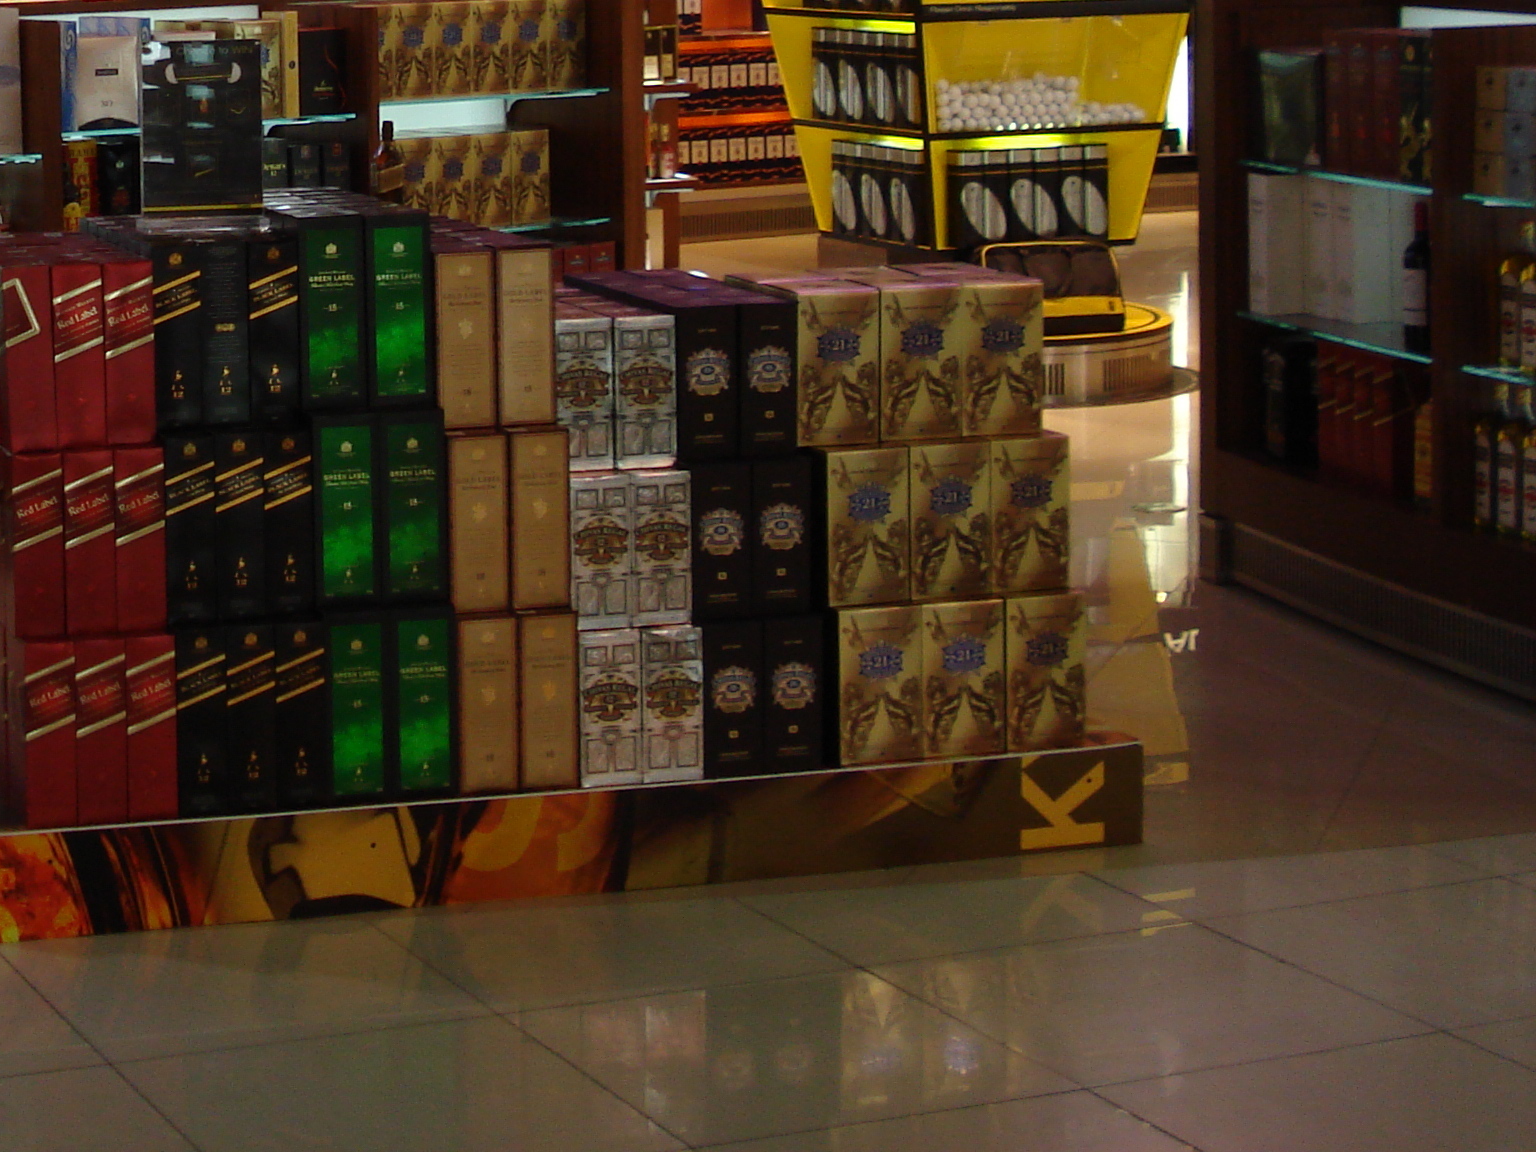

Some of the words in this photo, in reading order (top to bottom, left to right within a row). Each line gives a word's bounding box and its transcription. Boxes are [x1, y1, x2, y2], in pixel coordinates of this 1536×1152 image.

[57, 315, 75, 330] Red
[75, 307, 99, 325] Label
[108, 313, 126, 327] Red
[127, 303, 149, 322] Label
[16, 504, 34, 519] Red
[34, 496, 58, 513] Label
[68, 503, 86, 517] Red
[86, 493, 110, 510] Label
[118, 499, 135, 515] Red
[136, 490, 160, 508] Label
[29, 692, 46, 708] Red
[46, 684, 71, 702] Label
[80, 690, 97, 705] Red
[97, 681, 121, 699] Label
[131, 688, 147, 703] Red
[148, 679, 172, 697] Label
